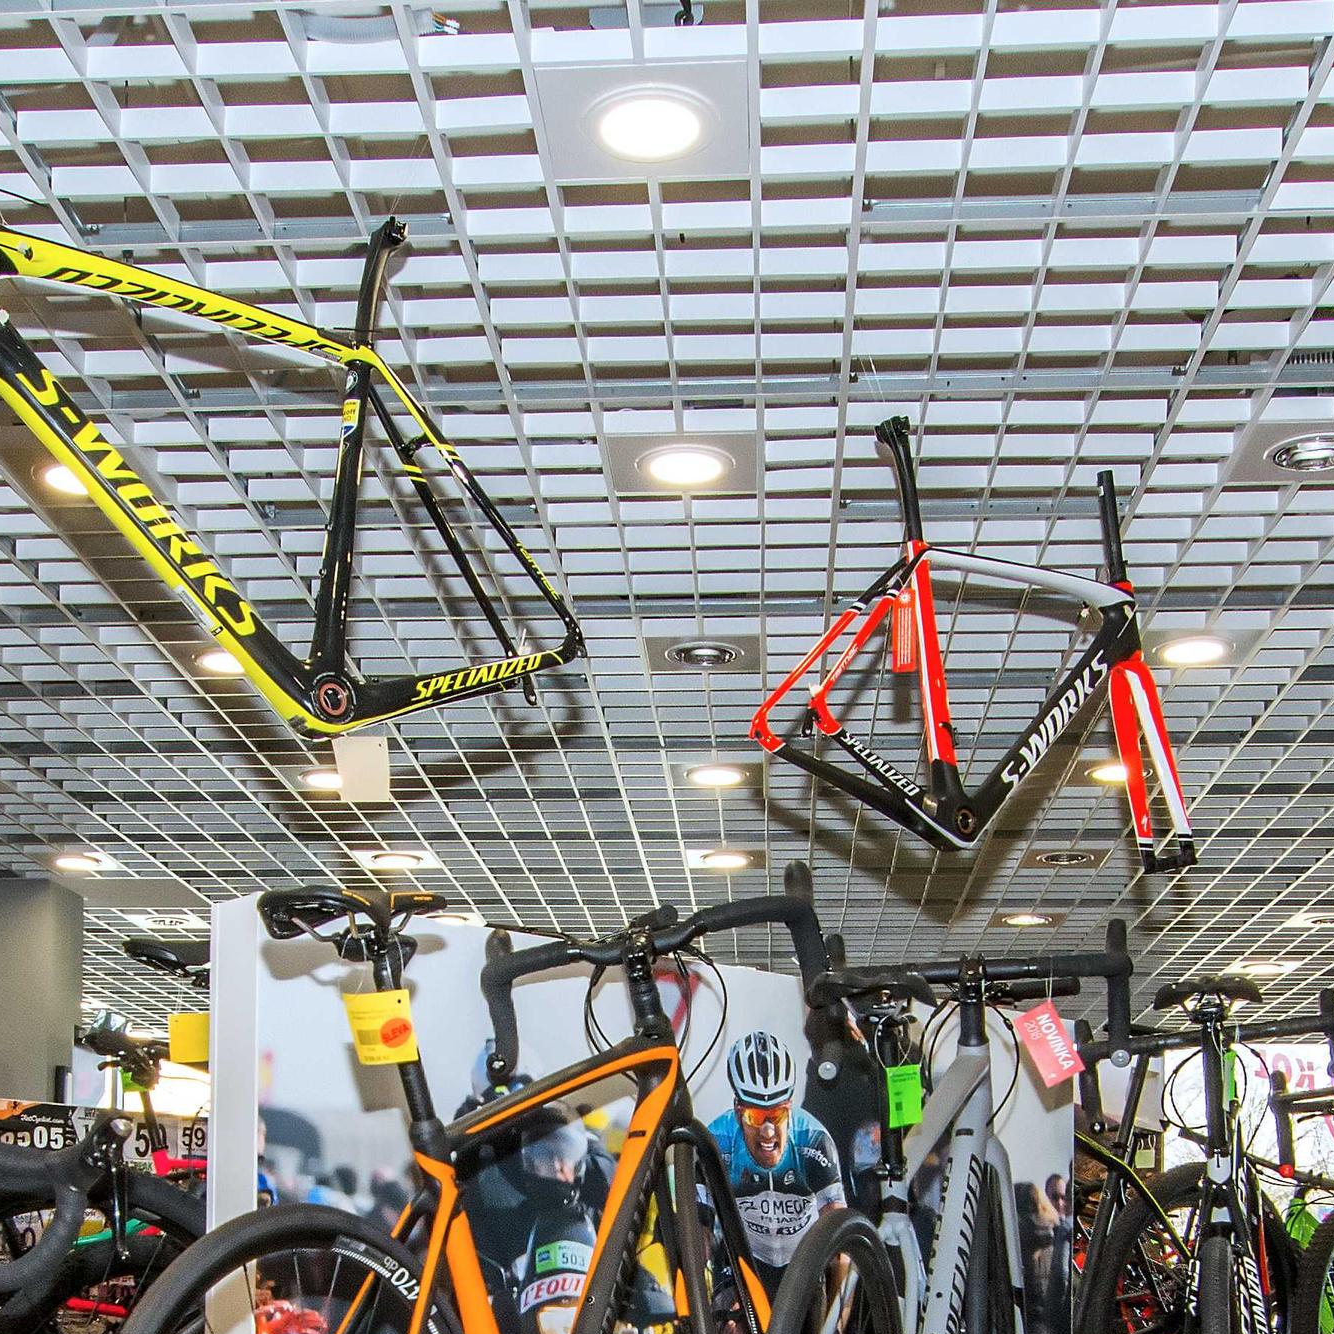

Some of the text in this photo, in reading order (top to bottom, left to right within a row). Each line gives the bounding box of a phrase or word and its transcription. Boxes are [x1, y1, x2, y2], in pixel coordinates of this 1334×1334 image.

[15, 367, 259, 637] S-WORKS
[413, 652, 542, 700] SPECIALIZED
[1000, 649, 1108, 790] S-WORKS
[840, 732, 921, 797] SPECIALIZED
[1036, 1013, 1075, 1071] NOVINKA
[760, 1198, 811, 1216] OMEGA
